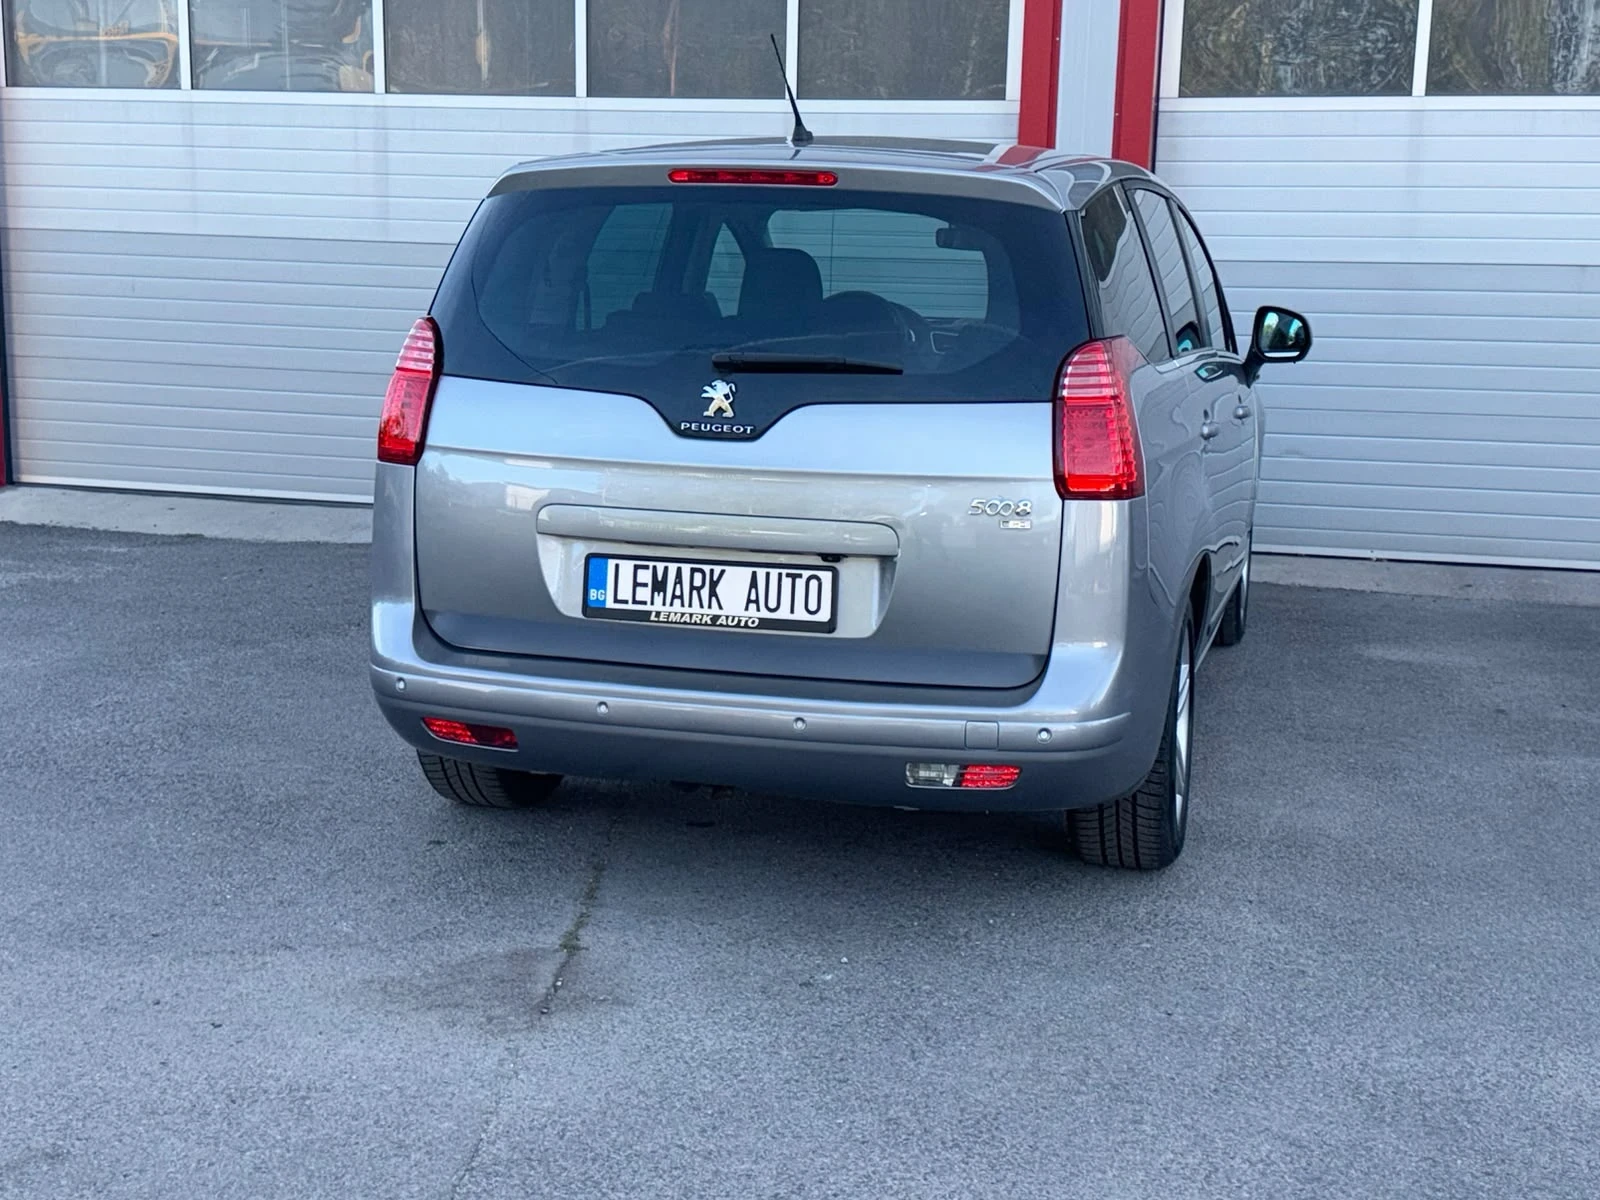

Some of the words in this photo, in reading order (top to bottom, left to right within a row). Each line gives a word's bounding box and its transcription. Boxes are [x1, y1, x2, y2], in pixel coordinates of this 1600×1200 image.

[680, 422, 754, 434] PEUGEOT
[968, 499, 1032, 516] 5008
[590, 588, 605, 600] BG
[612, 562, 726, 610] LEMARK
[744, 570, 822, 616] AUTO
[650, 611, 712, 625] LEMARK
[716, 616, 759, 628] AUTO
